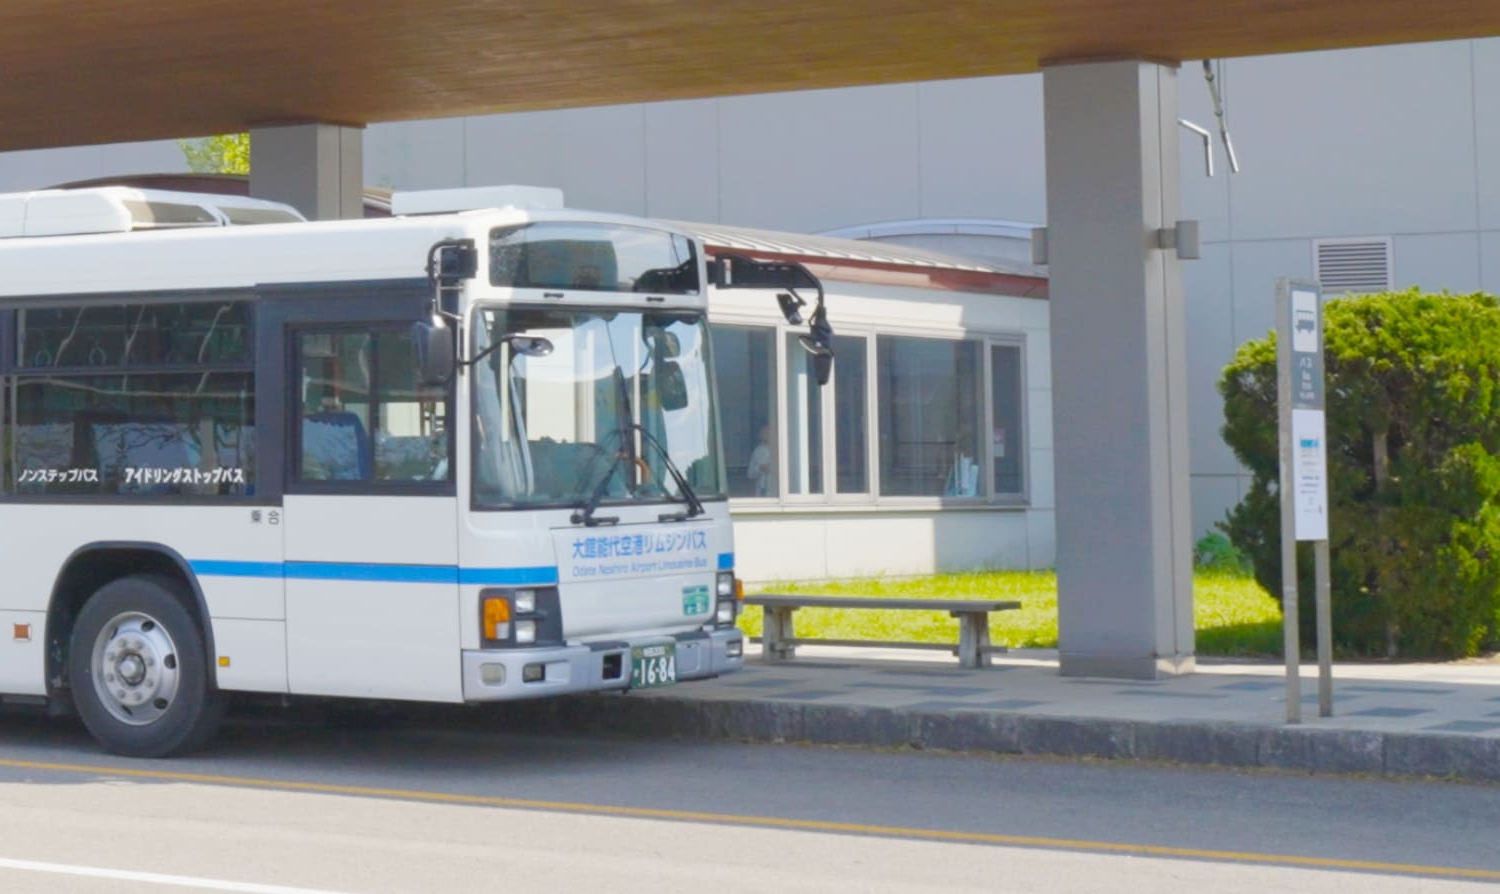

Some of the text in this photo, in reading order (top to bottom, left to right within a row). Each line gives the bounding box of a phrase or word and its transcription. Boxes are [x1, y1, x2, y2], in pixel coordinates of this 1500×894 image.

[18, 468, 98, 483] ノンステップバス
[124, 467, 244, 484] アイドリングストップバス
[572, 531, 707, 559] 大館能代空港リムジンバス
